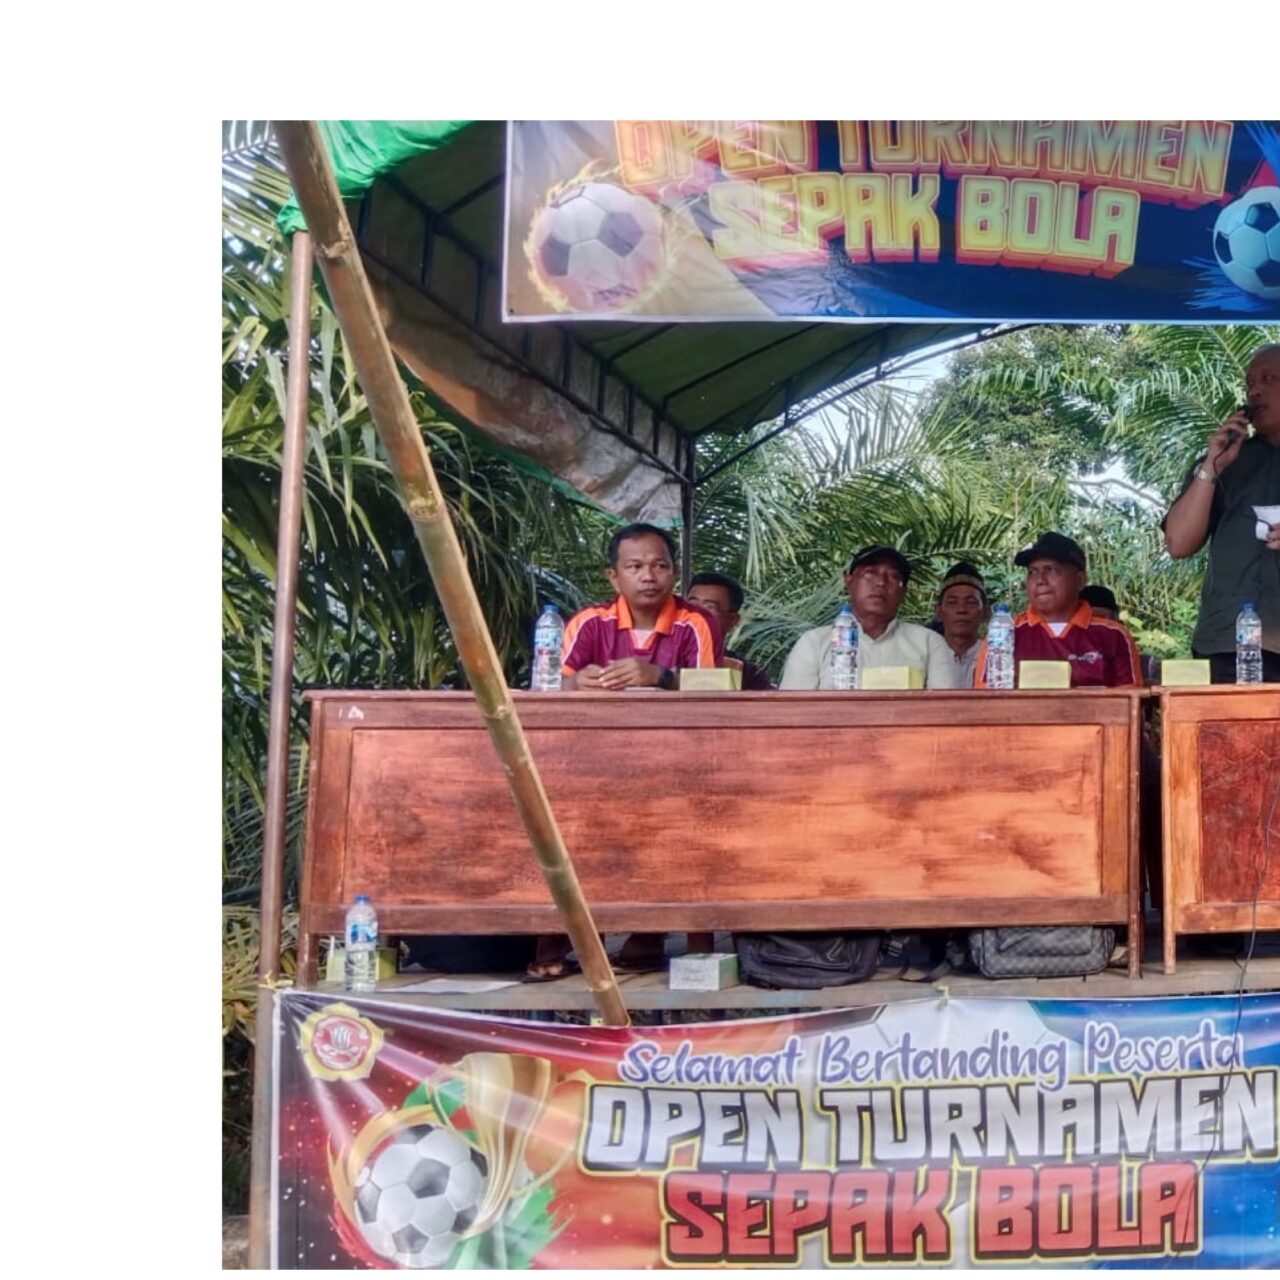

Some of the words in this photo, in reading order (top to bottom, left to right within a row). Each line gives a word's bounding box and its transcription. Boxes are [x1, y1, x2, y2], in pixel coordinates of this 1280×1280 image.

[709, 171, 940, 262] SEPAK
[956, 173, 1141, 266] BOLA
[621, 1037, 801, 1084] Selamat
[820, 1030, 1066, 1092] Bertanding
[1088, 1021, 1243, 1075] Peserta
[587, 1084, 804, 1168] OPEN
[820, 1070, 1278, 1163] TURNAMEN
[664, 1168, 952, 1259] SEPAK
[976, 1161, 1198, 1257] BOLA
